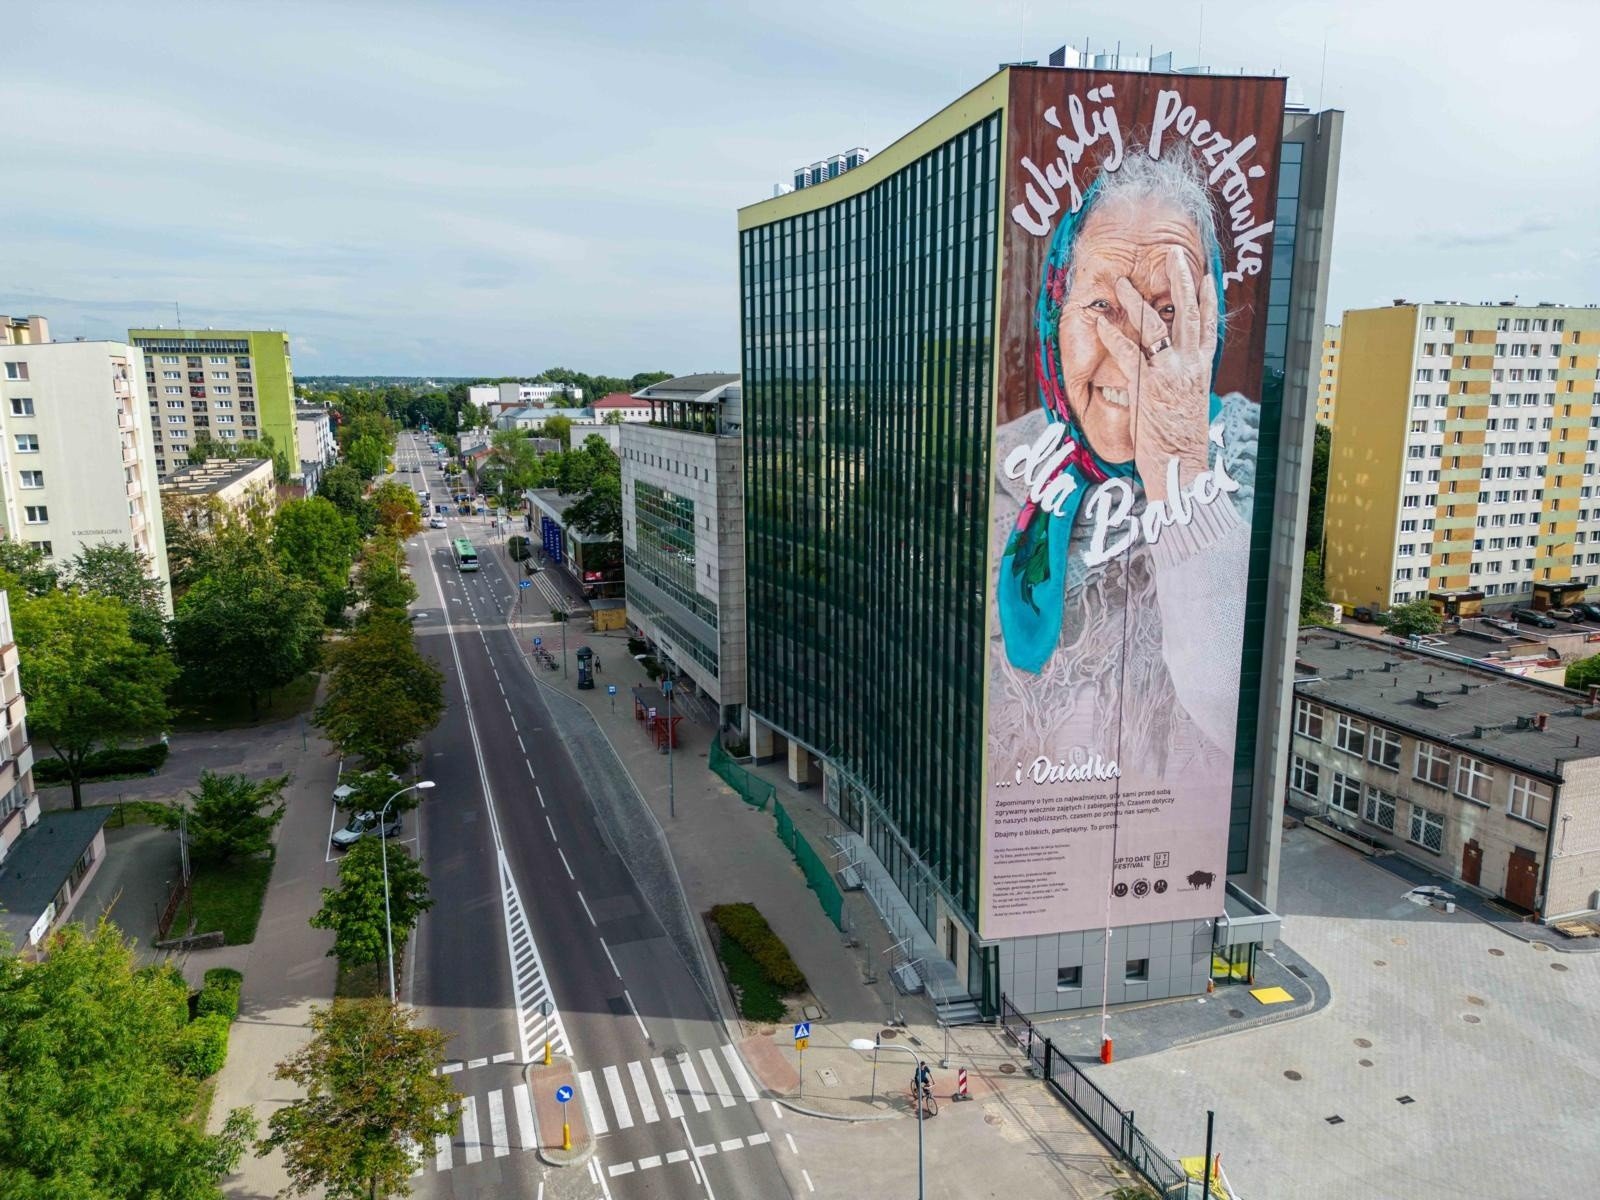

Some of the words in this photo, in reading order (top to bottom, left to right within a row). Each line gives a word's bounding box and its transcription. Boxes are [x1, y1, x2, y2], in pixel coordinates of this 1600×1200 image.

[1004, 422, 1077, 517] dla
[1080, 423, 1240, 567] Babci
[1027, 755, 1121, 785] Dziadka
[995, 808, 1027, 816] zgrywamy
[1029, 806, 1055, 814] wiecznie
[1056, 804, 1081, 812] zajętych
[1152, 797, 1174, 805] dotyczy
[996, 799, 1035, 808] Zapominamy
[1138, 789, 1155, 797] przed
[1003, 816, 1028, 825] naszych
[1103, 810, 1123, 818] prosu
[1098, 823, 1120, 831] prost.
[1114, 862, 1144, 870] FESTIVAL
